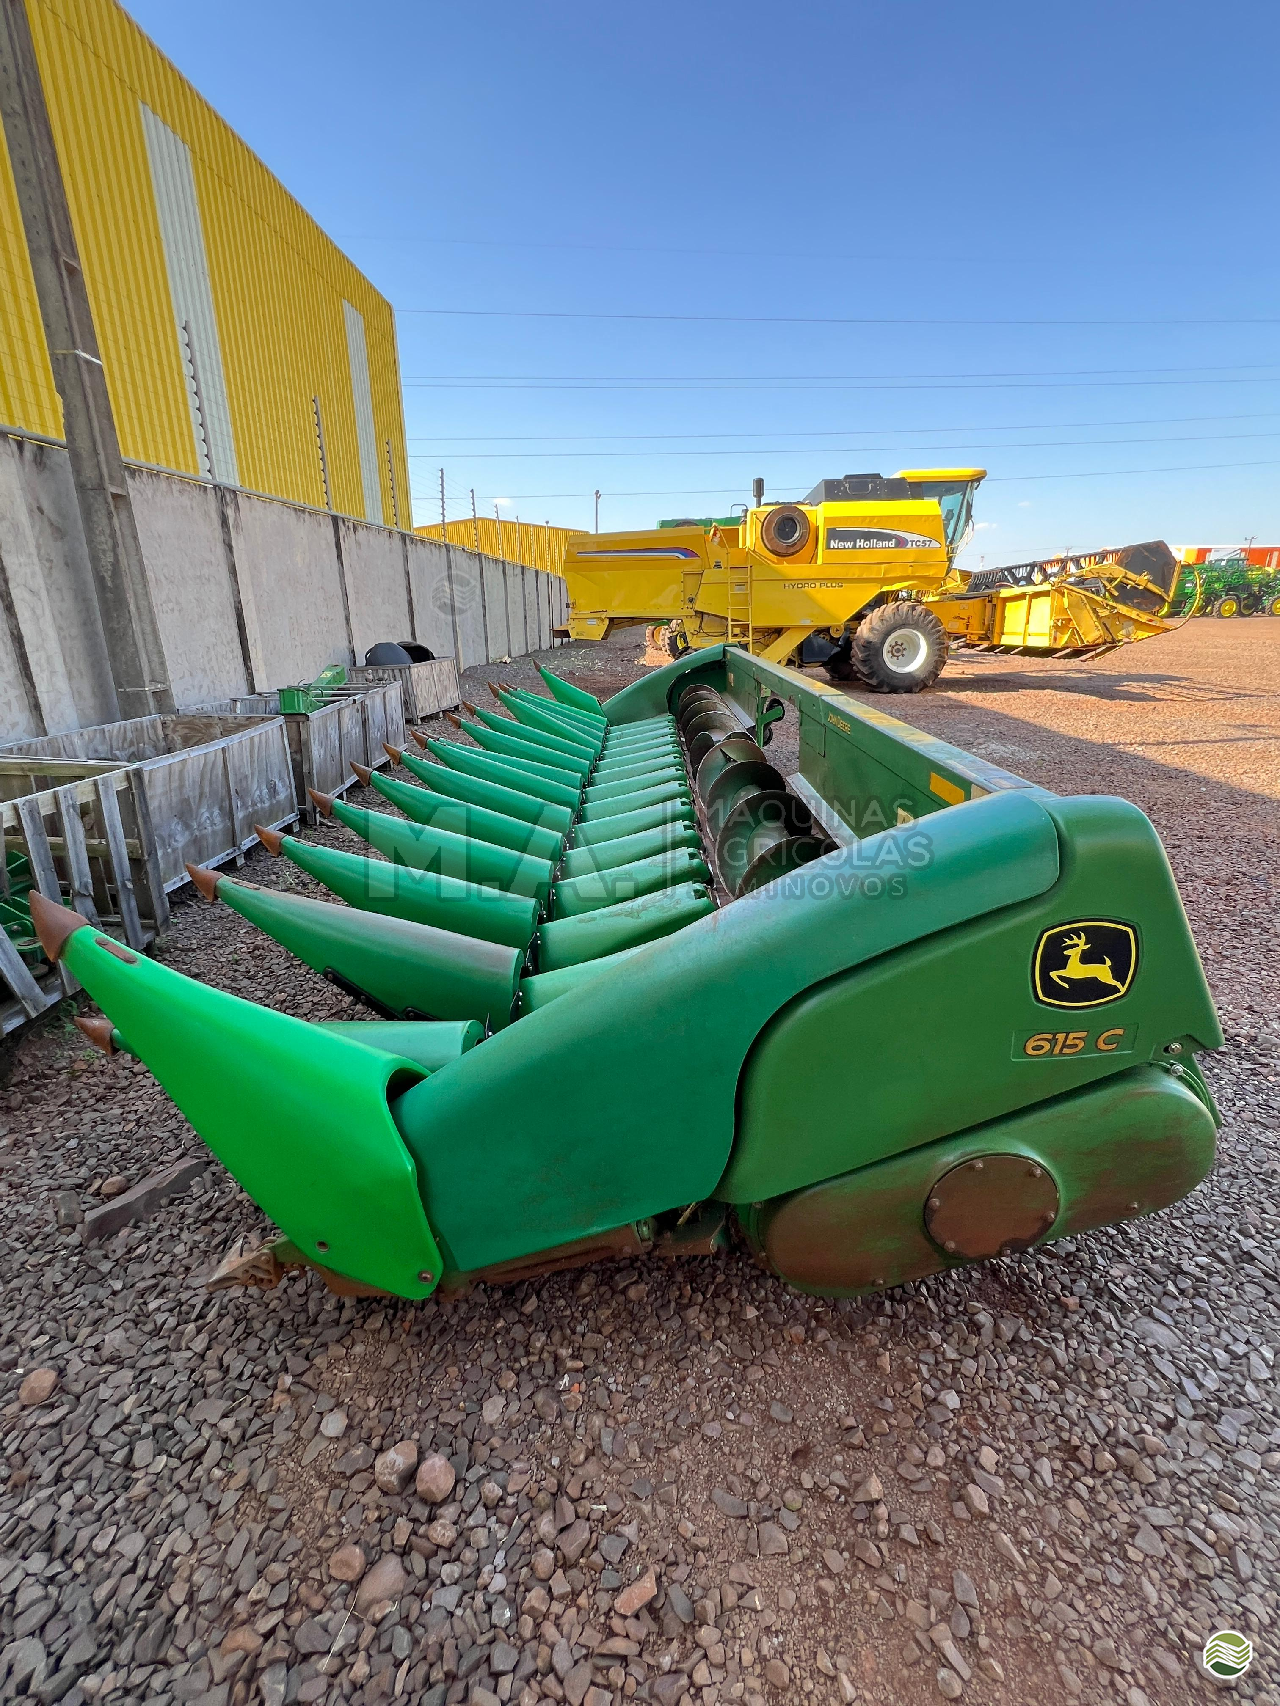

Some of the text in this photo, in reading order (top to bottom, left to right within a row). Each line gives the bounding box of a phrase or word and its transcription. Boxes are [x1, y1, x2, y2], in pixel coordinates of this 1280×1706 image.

[830, 538, 933, 549] New Holland TC57
[783, 582, 817, 590] HYDRO
[837, 715, 851, 735] DEERE
[1024, 1028, 1126, 1057] 615 C
